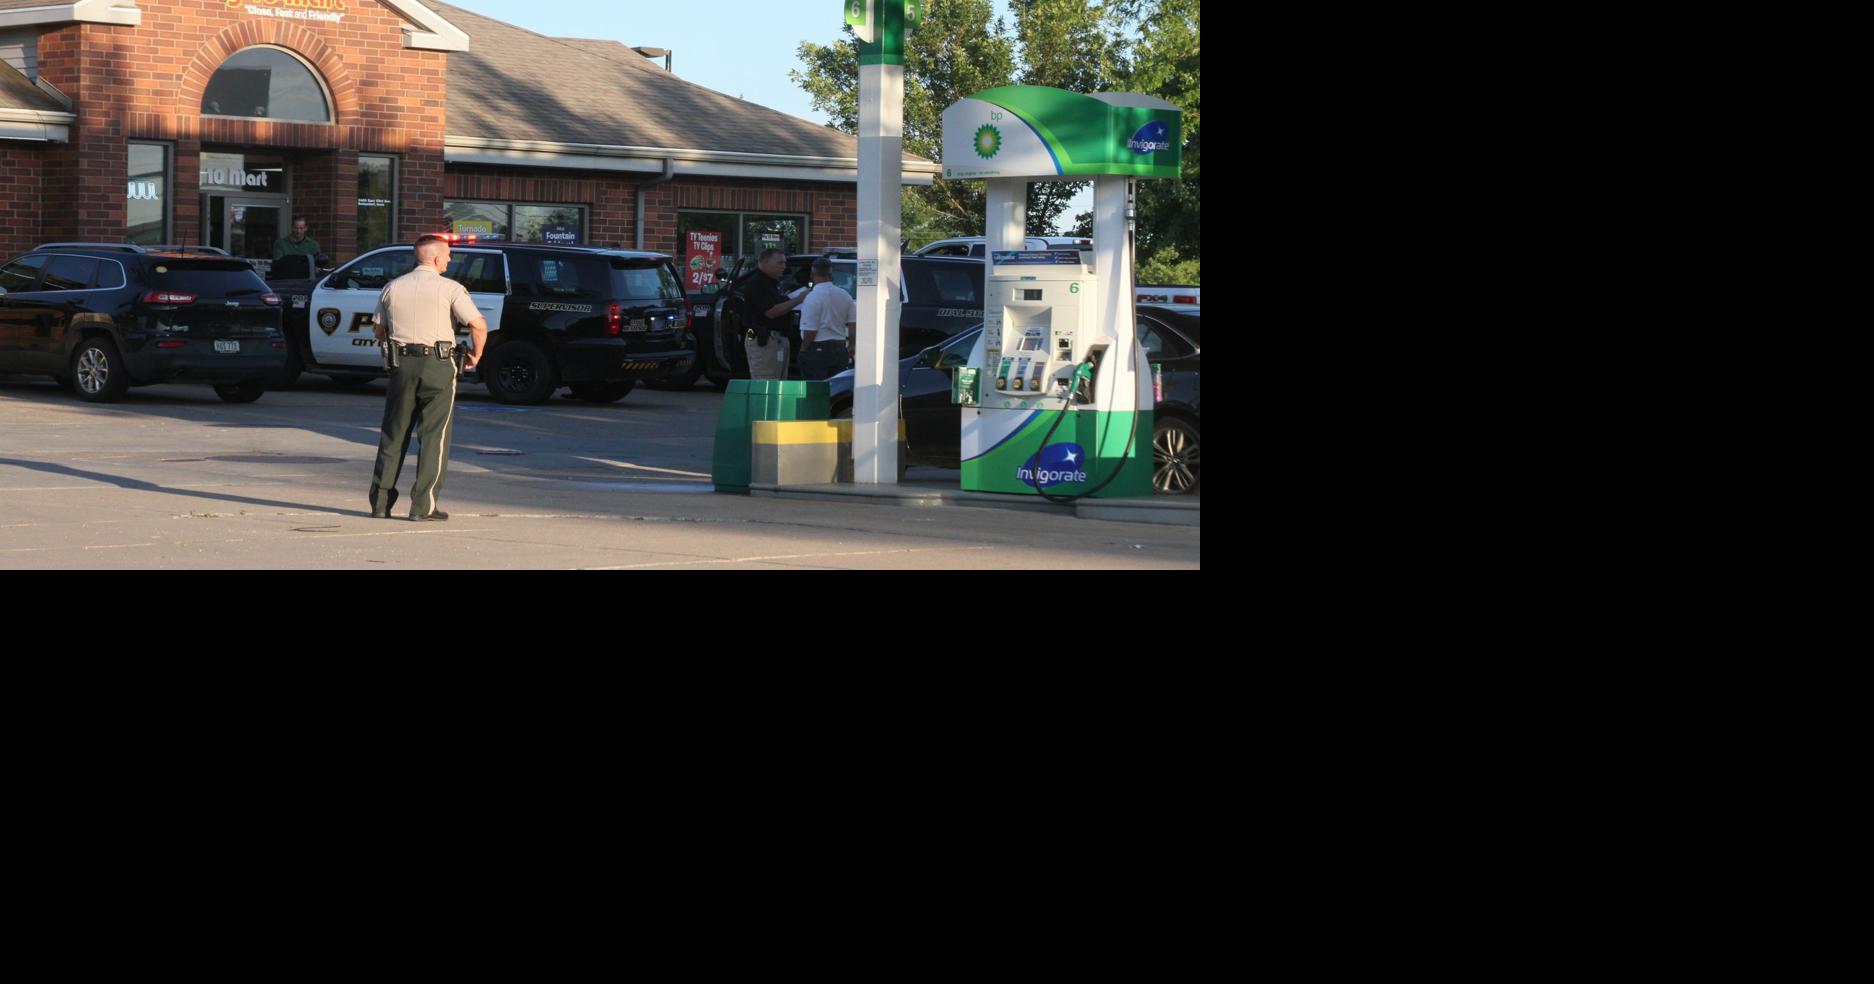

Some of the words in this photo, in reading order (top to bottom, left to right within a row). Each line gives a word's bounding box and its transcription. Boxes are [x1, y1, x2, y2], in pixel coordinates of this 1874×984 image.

[275, 8, 294, 17] Fast
[295, 9, 307, 18] and
[851, 0, 860, 18] 6
[907, 4, 916, 21] 5
[990, 110, 1003, 122] bp
[1127, 138, 1170, 152] Invigorate
[459, 224, 487, 233] Tornado
[546, 231, 575, 240] Fountain
[690, 232, 698, 241] TY
[694, 241, 701, 250] TY
[692, 271, 714, 285] 2/$7
[1069, 282, 1080, 294] 6
[529, 302, 593, 312] SUPERVISOR
[352, 338, 376, 346] CITY
[1016, 467, 1088, 484] Invigorate
